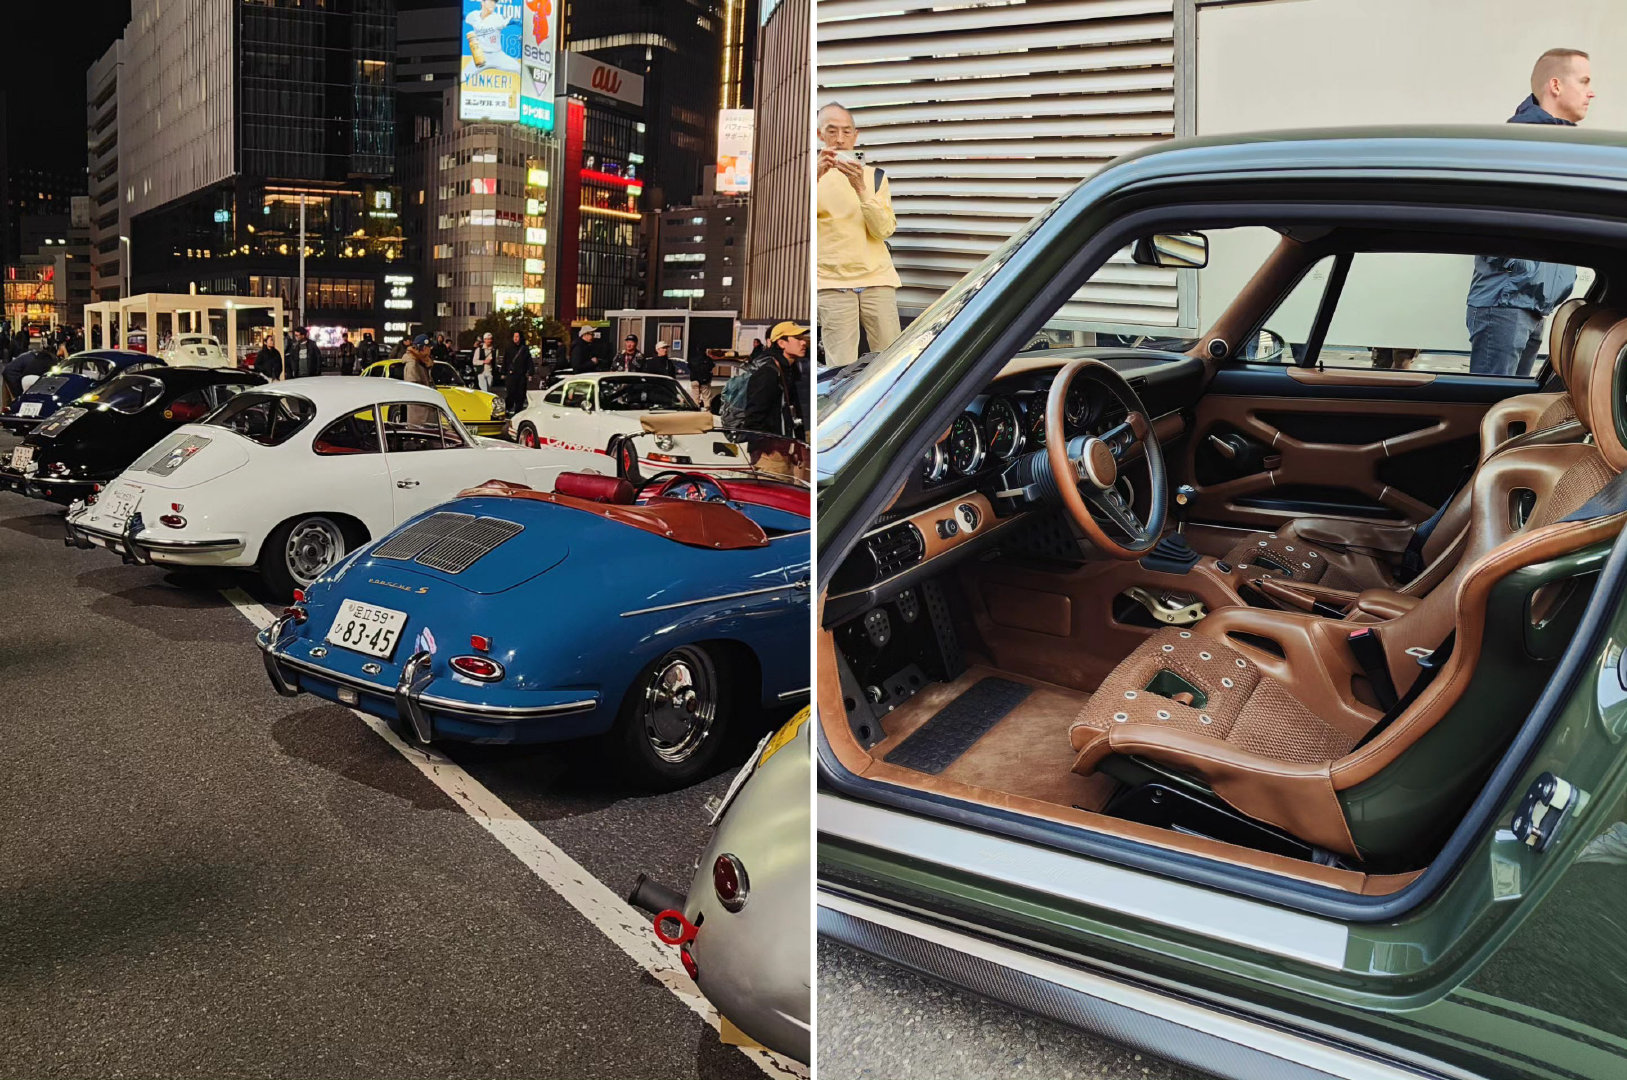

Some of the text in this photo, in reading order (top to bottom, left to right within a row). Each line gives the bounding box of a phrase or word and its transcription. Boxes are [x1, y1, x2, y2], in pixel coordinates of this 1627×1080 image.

[524, 44, 552, 64] sato
[592, 65, 622, 94] au
[414, 586, 430, 595] S
[342, 620, 395, 652] 83-45
